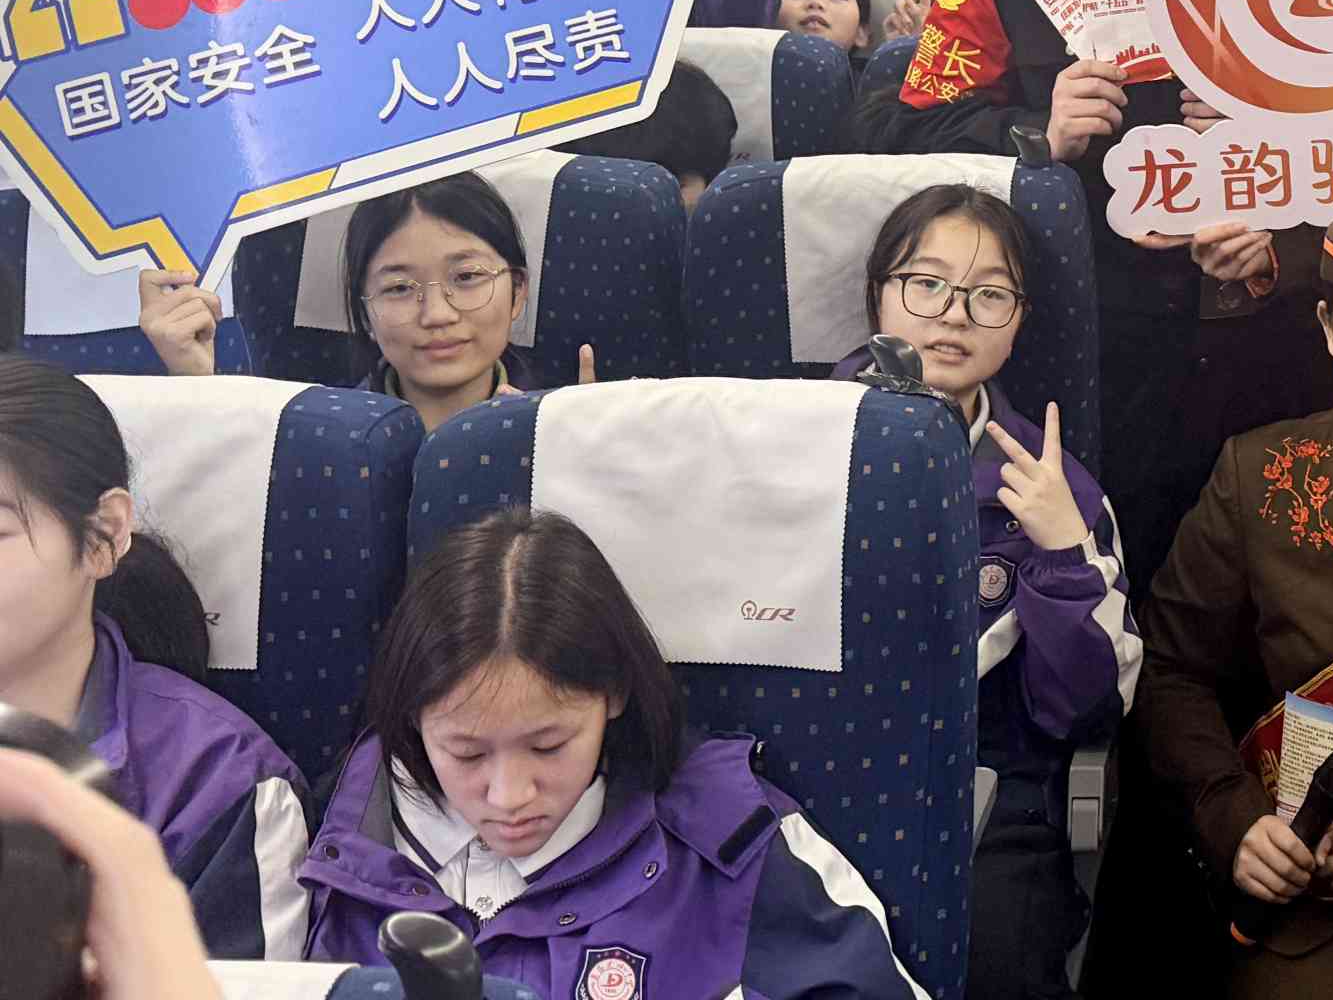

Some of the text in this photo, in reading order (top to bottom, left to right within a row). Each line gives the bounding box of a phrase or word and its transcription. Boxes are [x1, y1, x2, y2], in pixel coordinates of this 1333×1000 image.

[54, 25, 321, 138] 国家安全
[378, 8, 630, 121] 人人尽责
[916, 23, 981, 86] 警长
